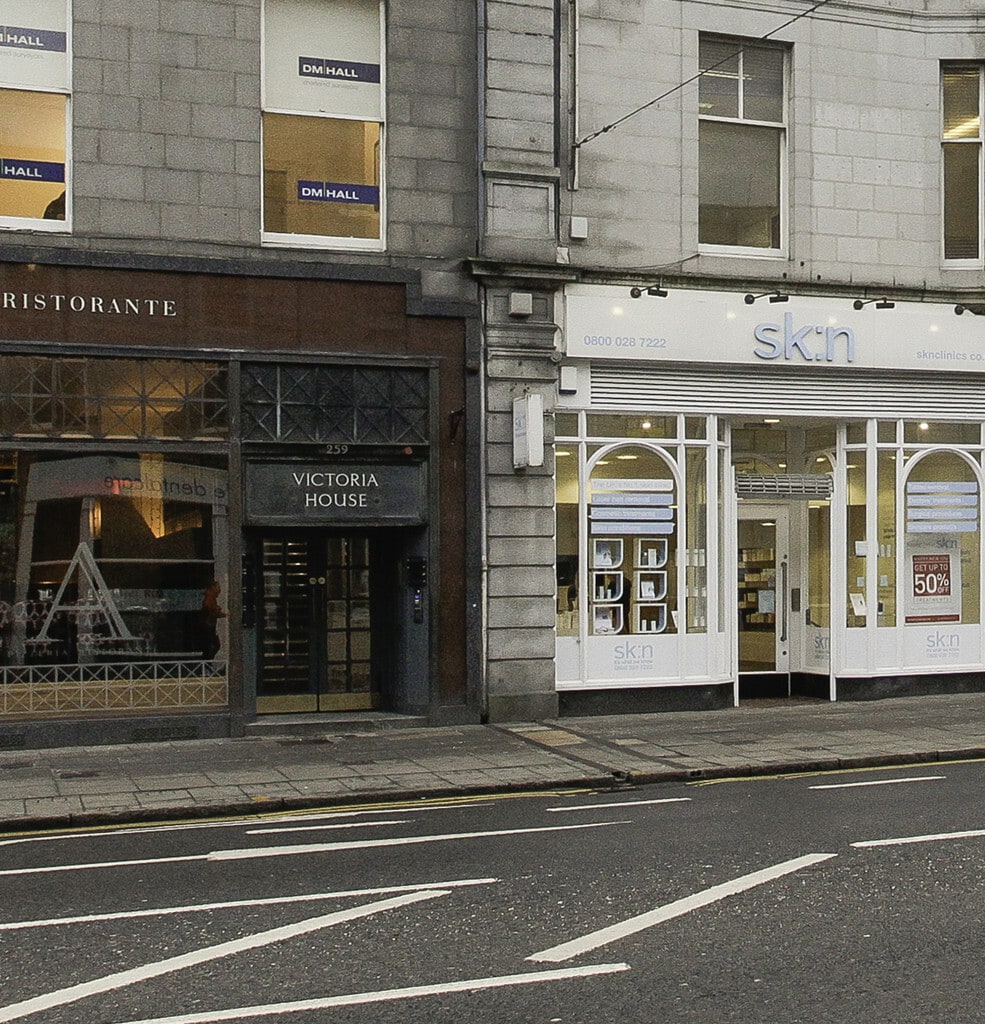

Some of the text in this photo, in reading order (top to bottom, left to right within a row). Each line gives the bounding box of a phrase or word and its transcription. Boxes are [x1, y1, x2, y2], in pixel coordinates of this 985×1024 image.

[7, 33, 45, 47] HALL
[302, 64, 358, 78] DM HALL
[4, 165, 43, 178] HALL
[301, 187, 360, 200] DM HALL
[2, 292, 177, 317] RISTORANTE
[583, 335, 667, 348] 0800 028 7222
[326, 444, 349, 455] 259
[292, 472, 379, 487] VICTORIA
[305, 493, 368, 507] HOUSE
[914, 563, 949, 572] GET UP TO
[914, 573, 950, 594] 50%
[937, 586, 950, 594] OFF
